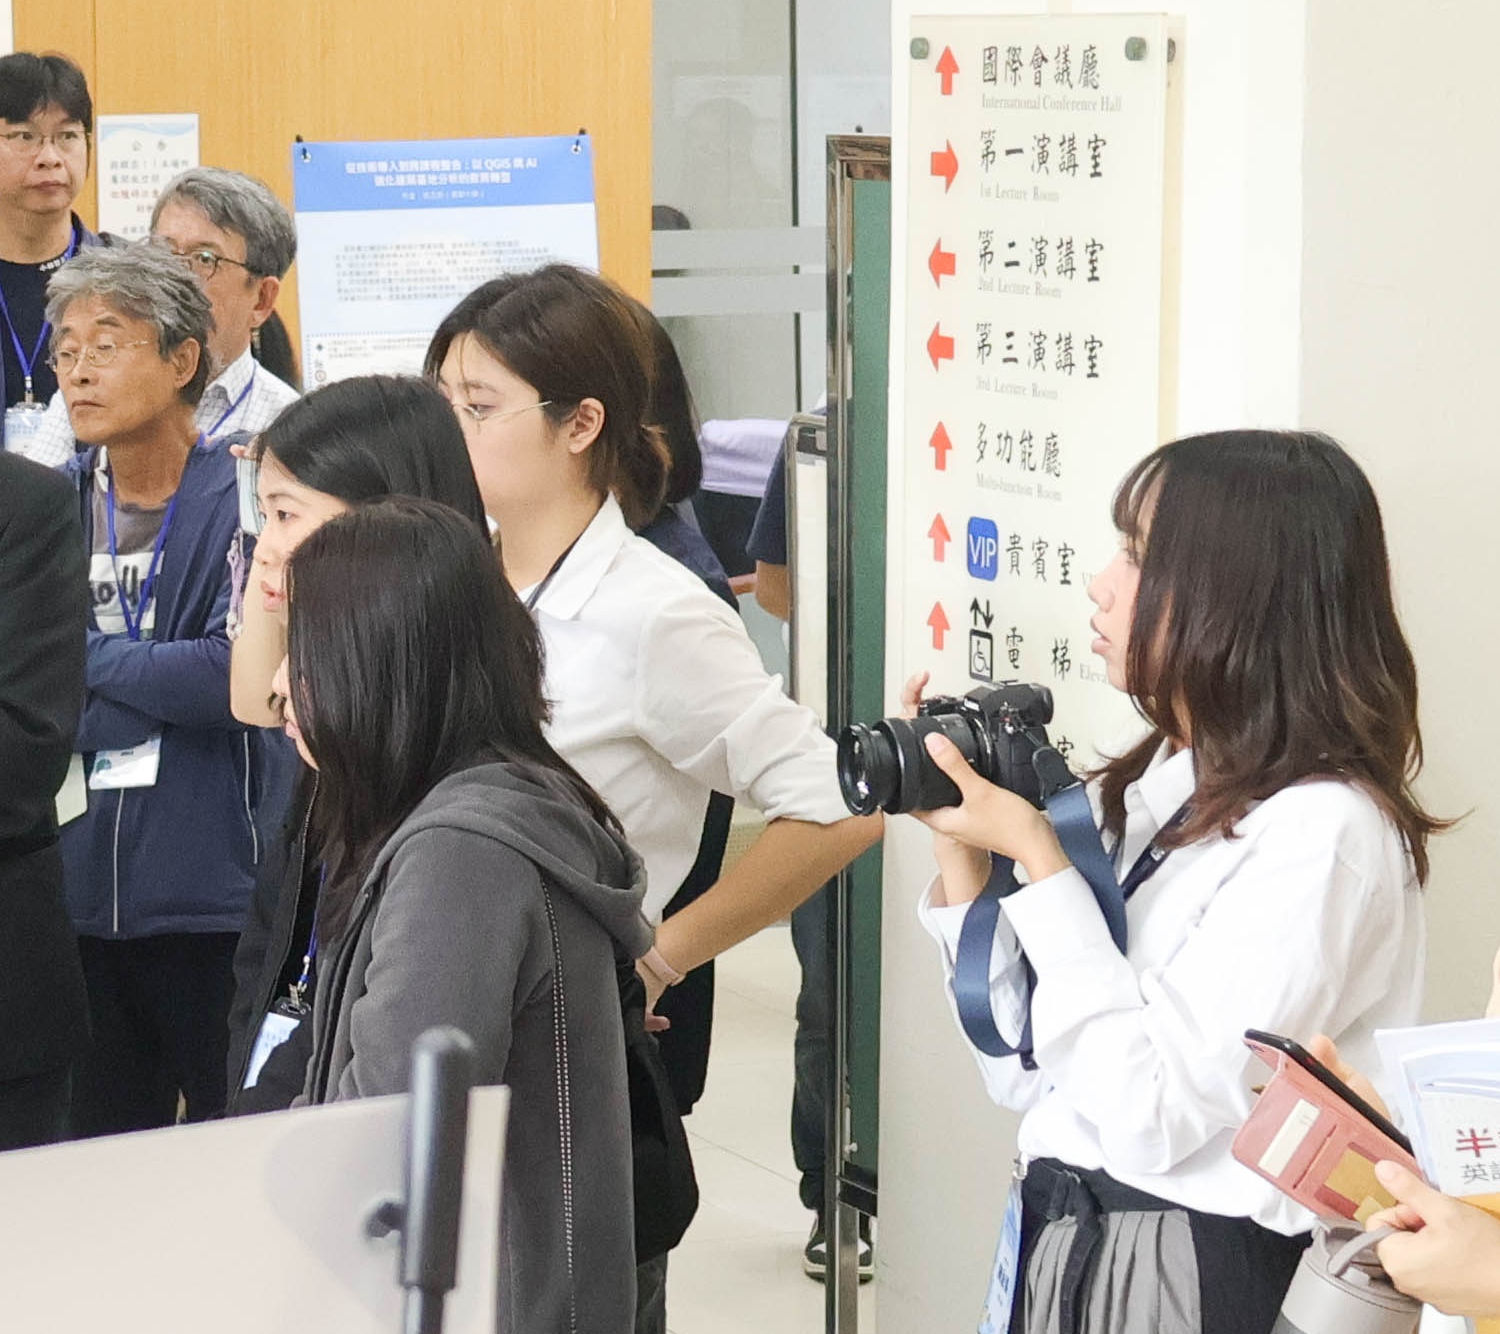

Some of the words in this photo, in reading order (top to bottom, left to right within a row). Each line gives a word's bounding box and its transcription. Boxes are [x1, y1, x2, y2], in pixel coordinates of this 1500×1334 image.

[982, 44, 1101, 90] 國際會議廳
[982, 94, 1041, 110] International
[1042, 95, 1097, 112] Conference
[1100, 95, 1122, 112] Hall
[979, 129, 1107, 179] 第一演講室
[995, 184, 1028, 201] Lecture
[1033, 186, 1060, 202] Room
[978, 230, 1105, 282] 第二演講室
[998, 278, 1031, 296] Lecture
[1035, 282, 1062, 298] Room
[976, 323, 1103, 379] 第三演講室
[995, 378, 1027, 396] Lecture
[1032, 383, 1059, 400] Room
[976, 421, 1062, 478] 多功能廳
[1036, 480, 1062, 502] Room
[969, 534, 997, 568] VIP
[1006, 534, 1075, 585] 貴賓室
